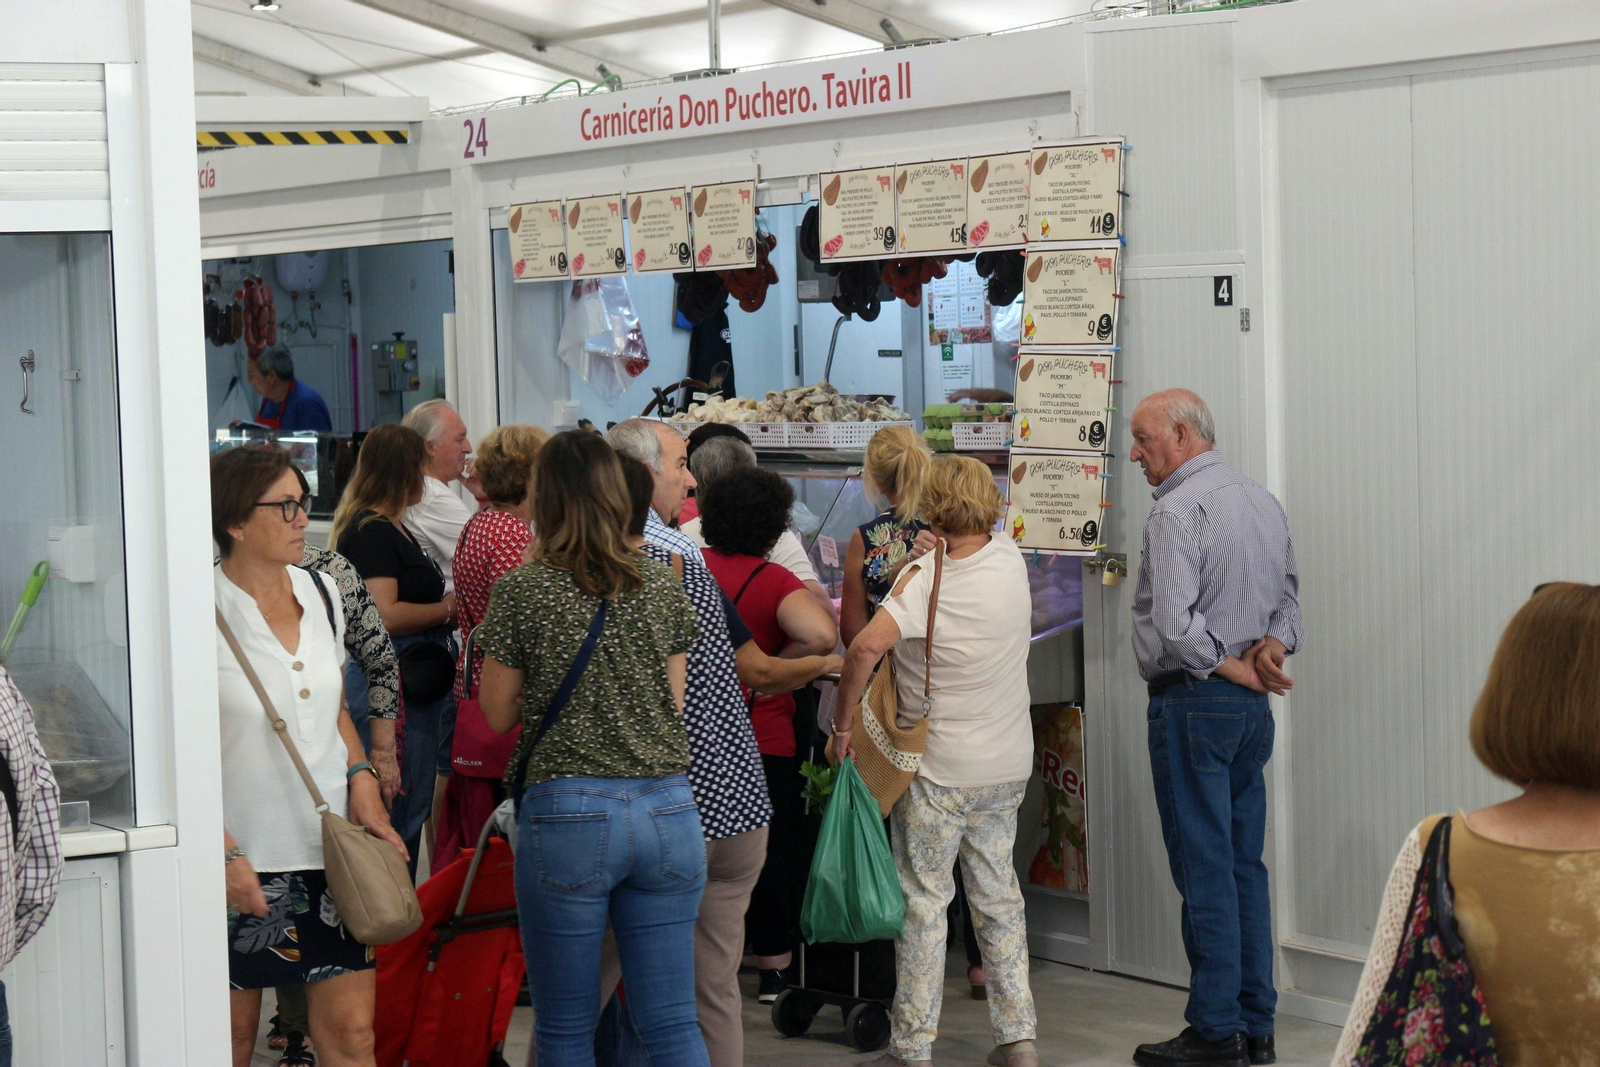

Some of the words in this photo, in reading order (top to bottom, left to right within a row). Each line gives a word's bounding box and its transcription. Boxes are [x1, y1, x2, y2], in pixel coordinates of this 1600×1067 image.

[580, 97, 673, 141] Carnicería
[680, 94, 719, 128] Don
[725, 80, 817, 123] Puchero.
[822, 67, 890, 109] Tavira
[463, 117, 488, 158] 24
[198, 161, 216, 188] cía
[1090, 216, 1101, 233] 11
[873, 227, 883, 240] 39
[950, 228, 960, 242] 15
[669, 243, 678, 256] 25
[550, 255, 556, 266] 11
[1219, 279, 1229, 302] 4
[1088, 320, 1095, 336] 9
[1079, 426, 1086, 441] 8
[1060, 527, 1081, 540] 6.50
